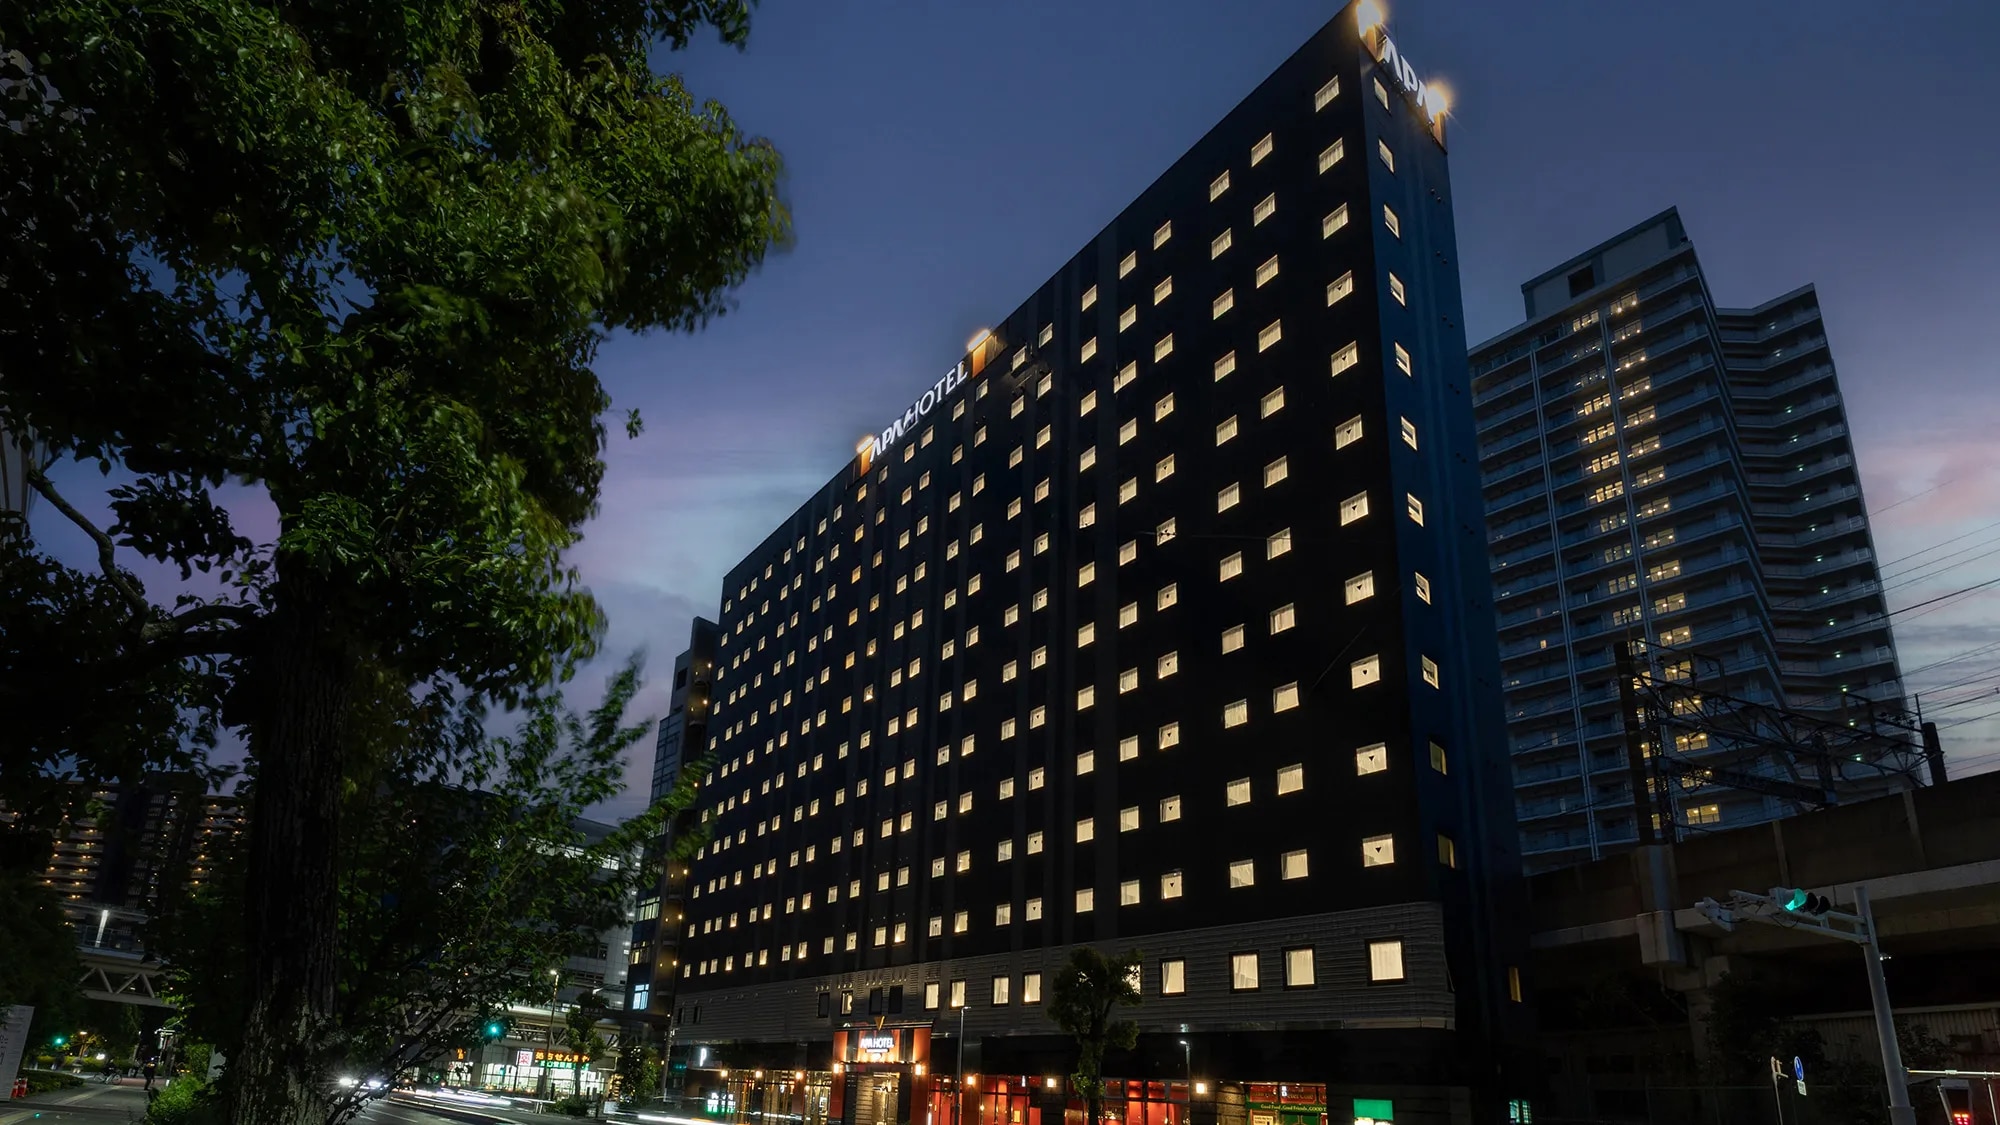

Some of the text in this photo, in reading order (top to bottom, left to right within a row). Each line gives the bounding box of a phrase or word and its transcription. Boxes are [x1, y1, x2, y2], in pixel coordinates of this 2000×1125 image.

[1382, 34, 1435, 125] APA
[869, 360, 968, 462] APA HOTEL
[860, 1037, 895, 1049] APA HOTEL
